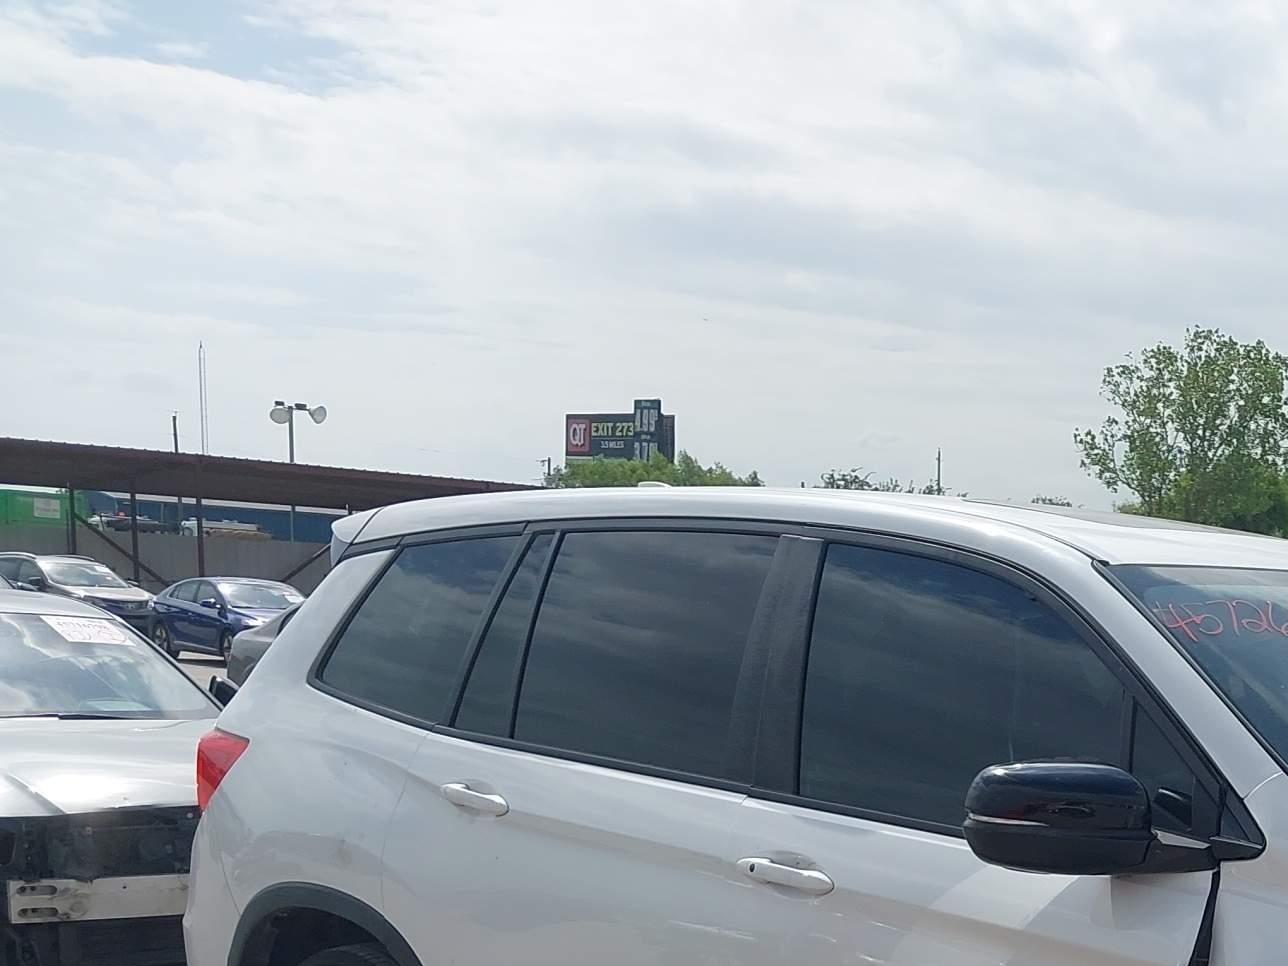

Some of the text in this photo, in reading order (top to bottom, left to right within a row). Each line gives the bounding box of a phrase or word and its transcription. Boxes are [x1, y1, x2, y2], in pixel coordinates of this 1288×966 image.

[569, 423, 586, 446] QT
[592, 422, 634, 436] EXIT 273
[609, 440, 625, 448] MILES
